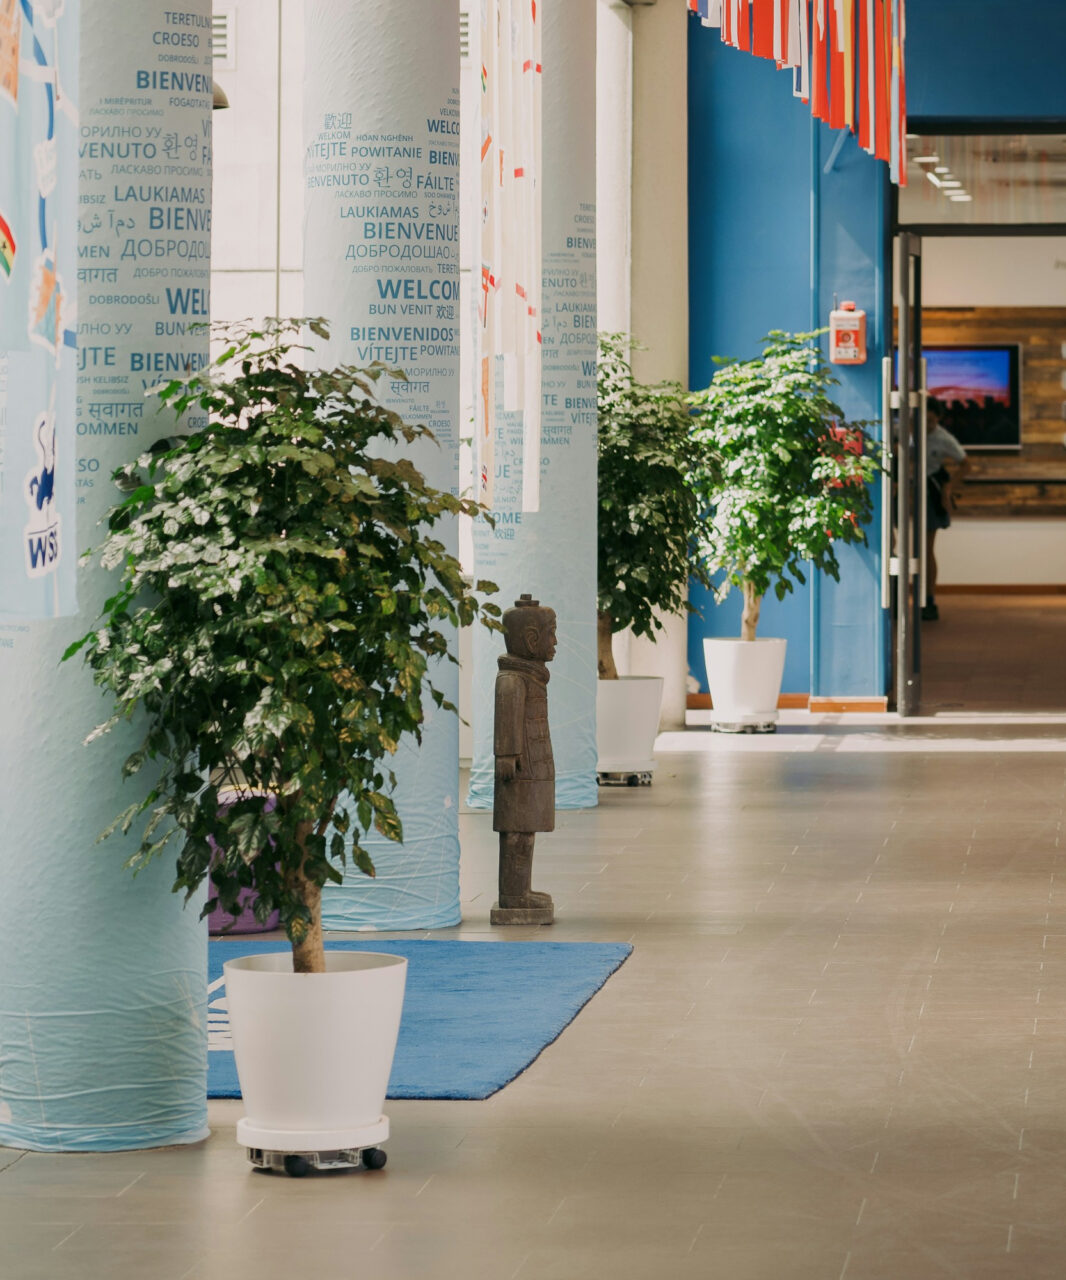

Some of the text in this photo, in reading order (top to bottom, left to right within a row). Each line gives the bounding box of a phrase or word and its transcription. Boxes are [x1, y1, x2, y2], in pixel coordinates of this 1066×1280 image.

[152, 31, 200, 48] CROESO
[351, 146, 422, 158] POWITANIE
[416, 171, 455, 191] FÁILTE
[114, 184, 205, 204] LAUKIAMAS
[334, 189, 418, 198] ЛАСКАВО ПРОСИМО
[340, 206, 419, 219] LAUKIAMAS
[364, 222, 459, 242] BIENVENUE
[352, 265, 380, 274] ДОБРО
[88, 292, 160, 305] DOBRODOŠLI
[369, 304, 433, 315] BUN VENIT
[155, 321, 185, 336] BUN
[351, 327, 454, 342] BIENVENIDOS
[357, 342, 418, 363] VÍTEJTE
